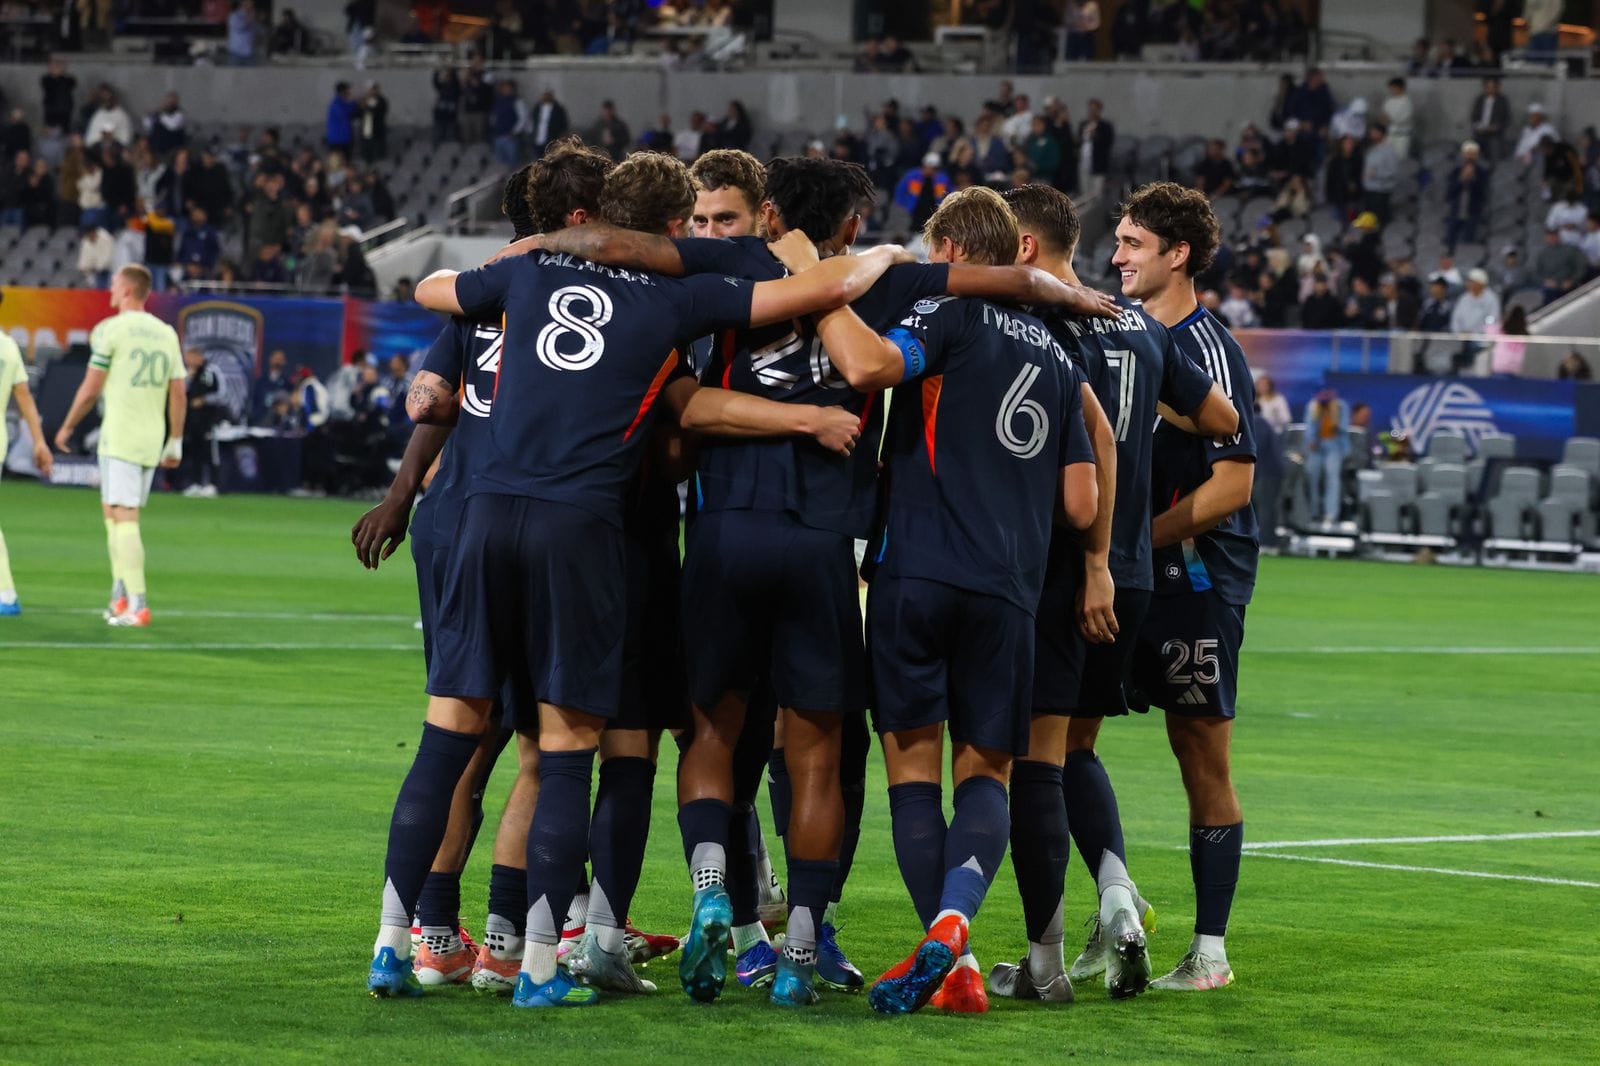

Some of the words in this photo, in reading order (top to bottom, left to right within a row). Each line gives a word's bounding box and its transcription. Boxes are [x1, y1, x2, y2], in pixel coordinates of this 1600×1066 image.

[128, 347, 170, 388] 20
[536, 284, 613, 371] 8
[995, 362, 1050, 459] 6
[1104, 350, 1136, 442] 7
[1161, 638, 1221, 685] 25
